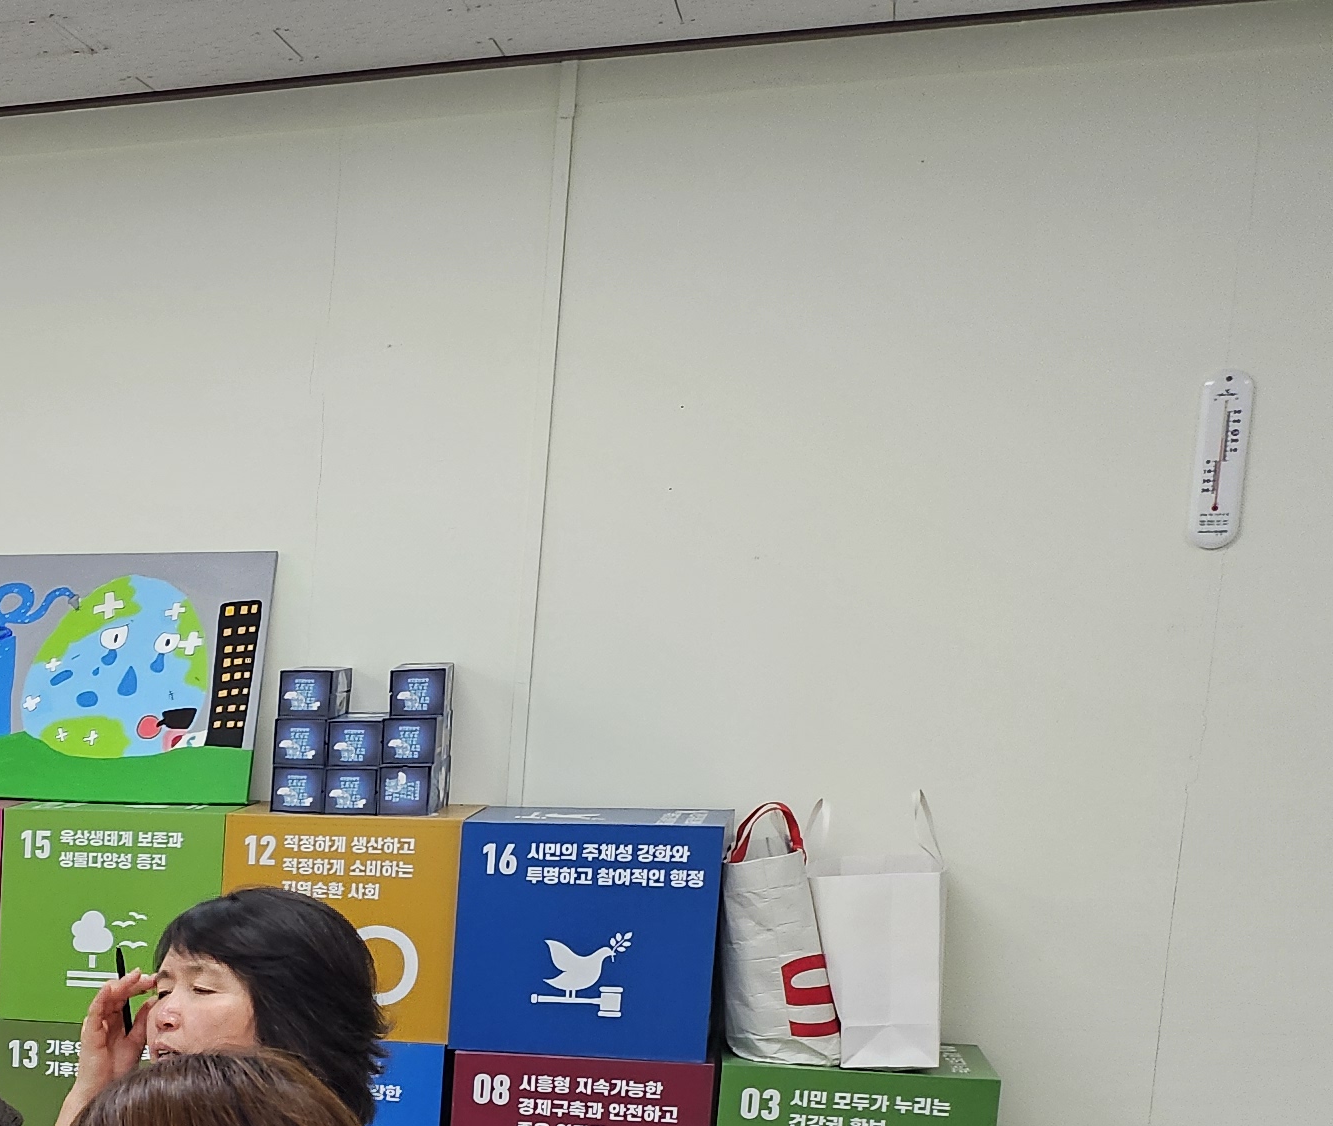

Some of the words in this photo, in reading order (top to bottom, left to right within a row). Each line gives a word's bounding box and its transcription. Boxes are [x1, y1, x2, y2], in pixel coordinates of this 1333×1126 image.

[20, 830, 52, 859] 15
[59, 830, 133, 847] 육상생태계
[137, 831, 184, 848] 보존과
[244, 835, 276, 866] 12
[283, 835, 346, 853] 적정하게
[350, 836, 415, 854] 생산하고
[59, 851, 132, 869] 생물다양성
[136, 854, 166, 870] 증진
[482, 842, 518, 875] 16
[527, 843, 577, 861] 시민의
[581, 843, 632, 862] 주체성
[637, 844, 690, 863] 강화와
[282, 857, 344, 876] 적정하게
[348, 860, 414, 878] 소비하는
[525, 867, 593, 886] 투명하고
[597, 867, 664, 887] 참여적인
[670, 869, 704, 888] 행정
[348, 881, 380, 900] 사회
[8, 1039, 38, 1068] 13
[472, 1073, 511, 1106] 08
[519, 1074, 570, 1095] 시흥형
[575, 1077, 664, 1100] 지속가능한
[517, 1097, 604, 1120] 경제구축과
[609, 1102, 679, 1124] 안전하고
[740, 1087, 781, 1121] 03
[789, 1089, 827, 1109] 시민
[833, 1092, 890, 1113] 모두가
[894, 1095, 951, 1117] 누리는
